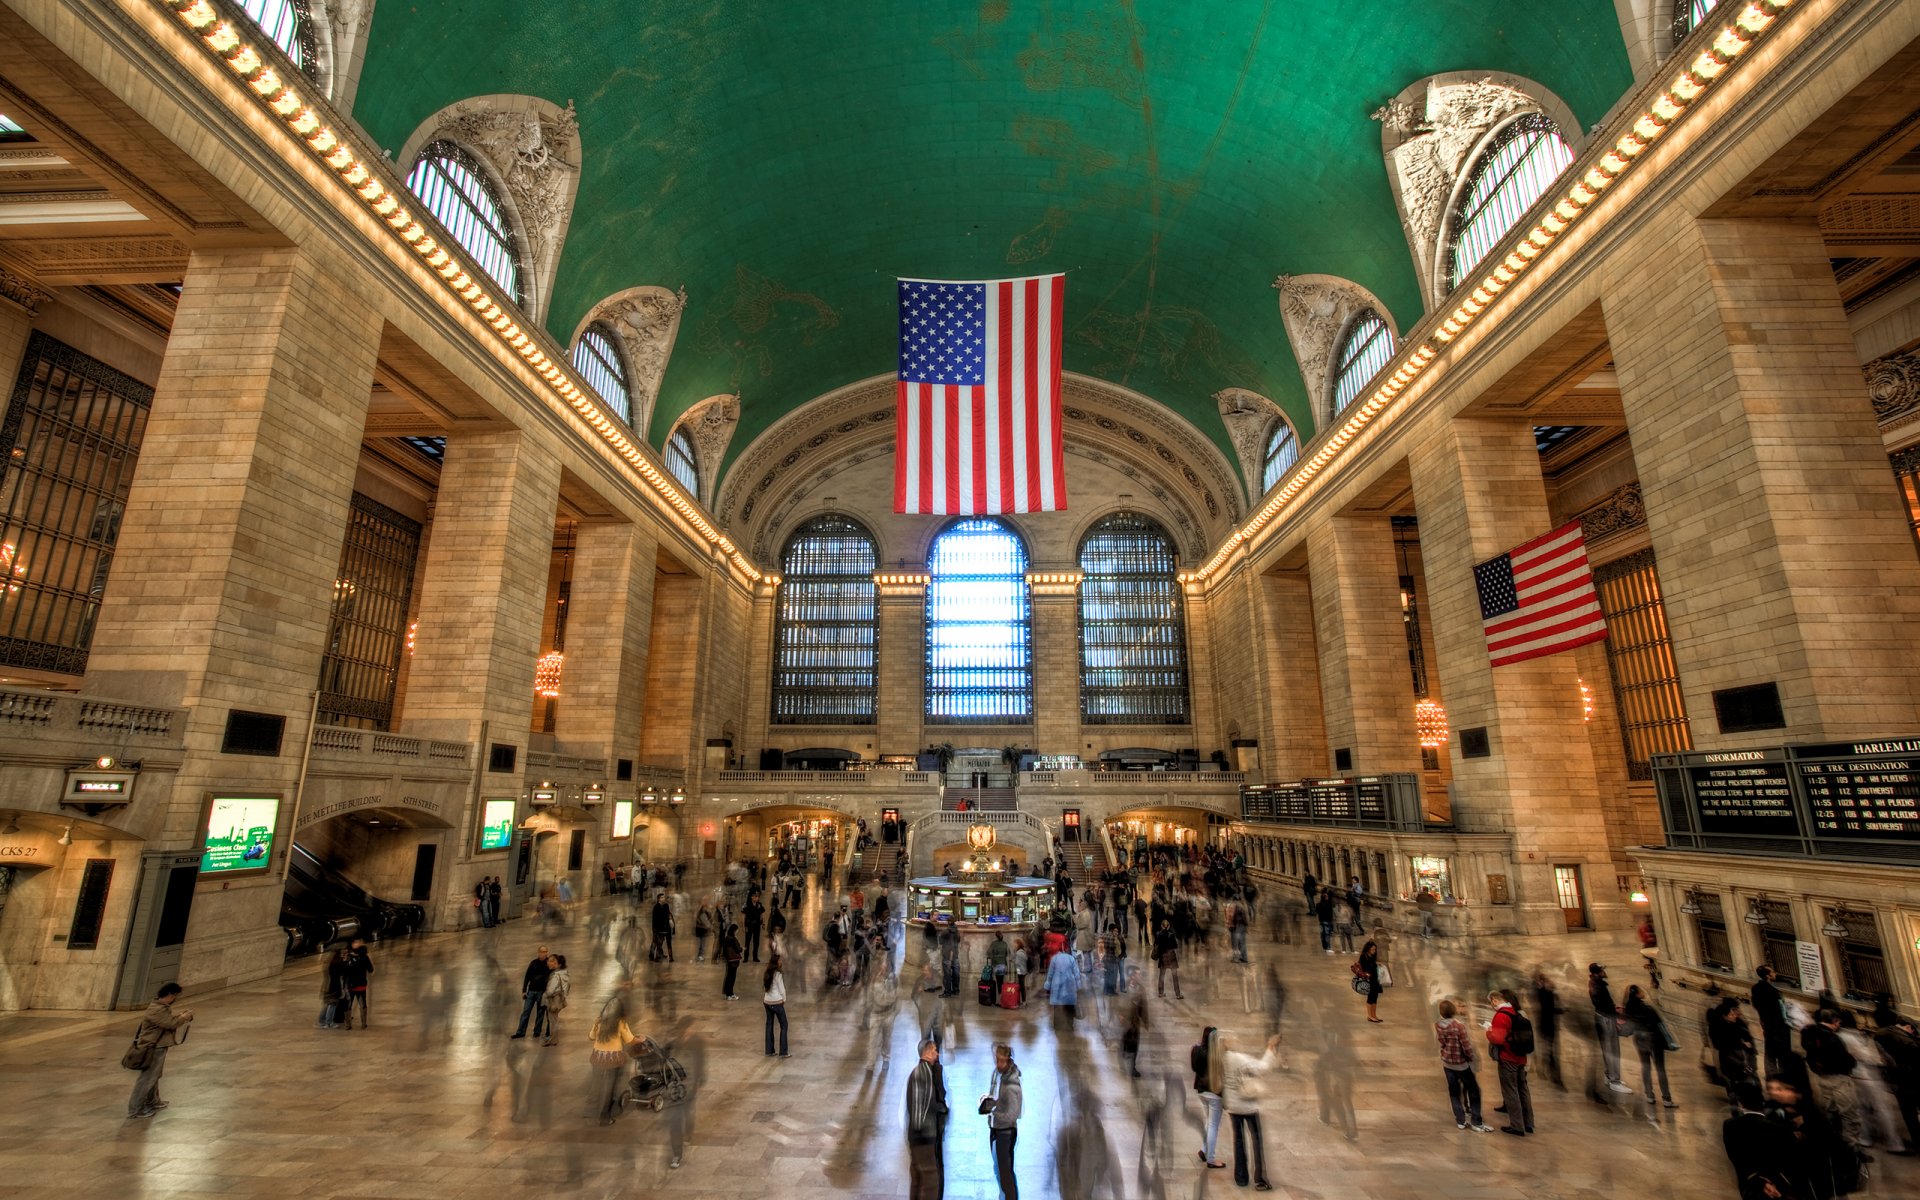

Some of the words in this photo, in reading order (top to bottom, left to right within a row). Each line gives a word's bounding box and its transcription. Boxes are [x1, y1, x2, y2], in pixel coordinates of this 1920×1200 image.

[1854, 742, 1904, 754] HARLEM
[1705, 752, 1764, 762] INFORMATION
[1802, 765, 1822, 773] TIME
[1827, 764, 1845, 772] TRK
[1849, 762, 1909, 771] DESTINATION
[1881, 774, 1908, 782] PLAINS
[1857, 787, 1894, 795] SOUTHEAST
[313, 801, 347, 820] METLIFE
[348, 795, 382, 808] BUILDING
[418, 799, 439, 811] STREET
[1121, 801, 1151, 810] LEXINGTON
[1888, 799, 1915, 807] PLAINS
[1890, 811, 1918, 819] PLAINS
[1865, 822, 1903, 830] SOUTHEAST
[24, 847, 37, 856] 27
